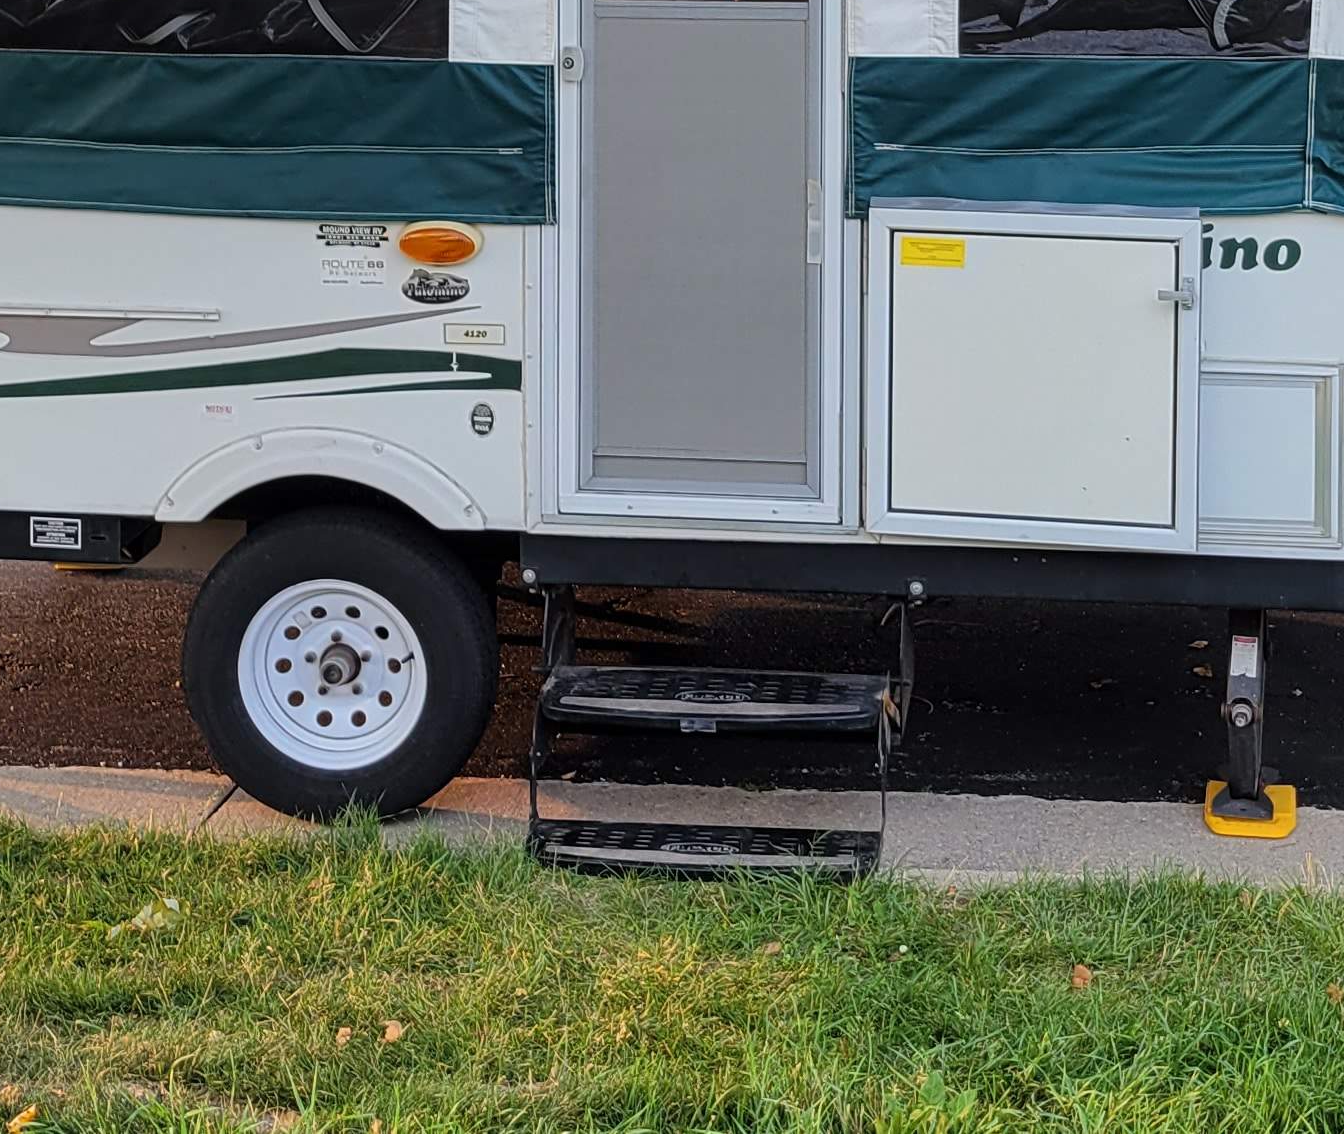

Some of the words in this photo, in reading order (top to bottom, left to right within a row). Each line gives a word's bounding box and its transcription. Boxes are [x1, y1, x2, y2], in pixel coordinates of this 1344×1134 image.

[322, 225, 350, 234] MOUND
[351, 226, 371, 235] VIEW
[372, 227, 384, 235] RV
[321, 259, 365, 269] ROUTE
[407, 282, 466, 297] Palomino
[463, 329, 488, 339] 4120
